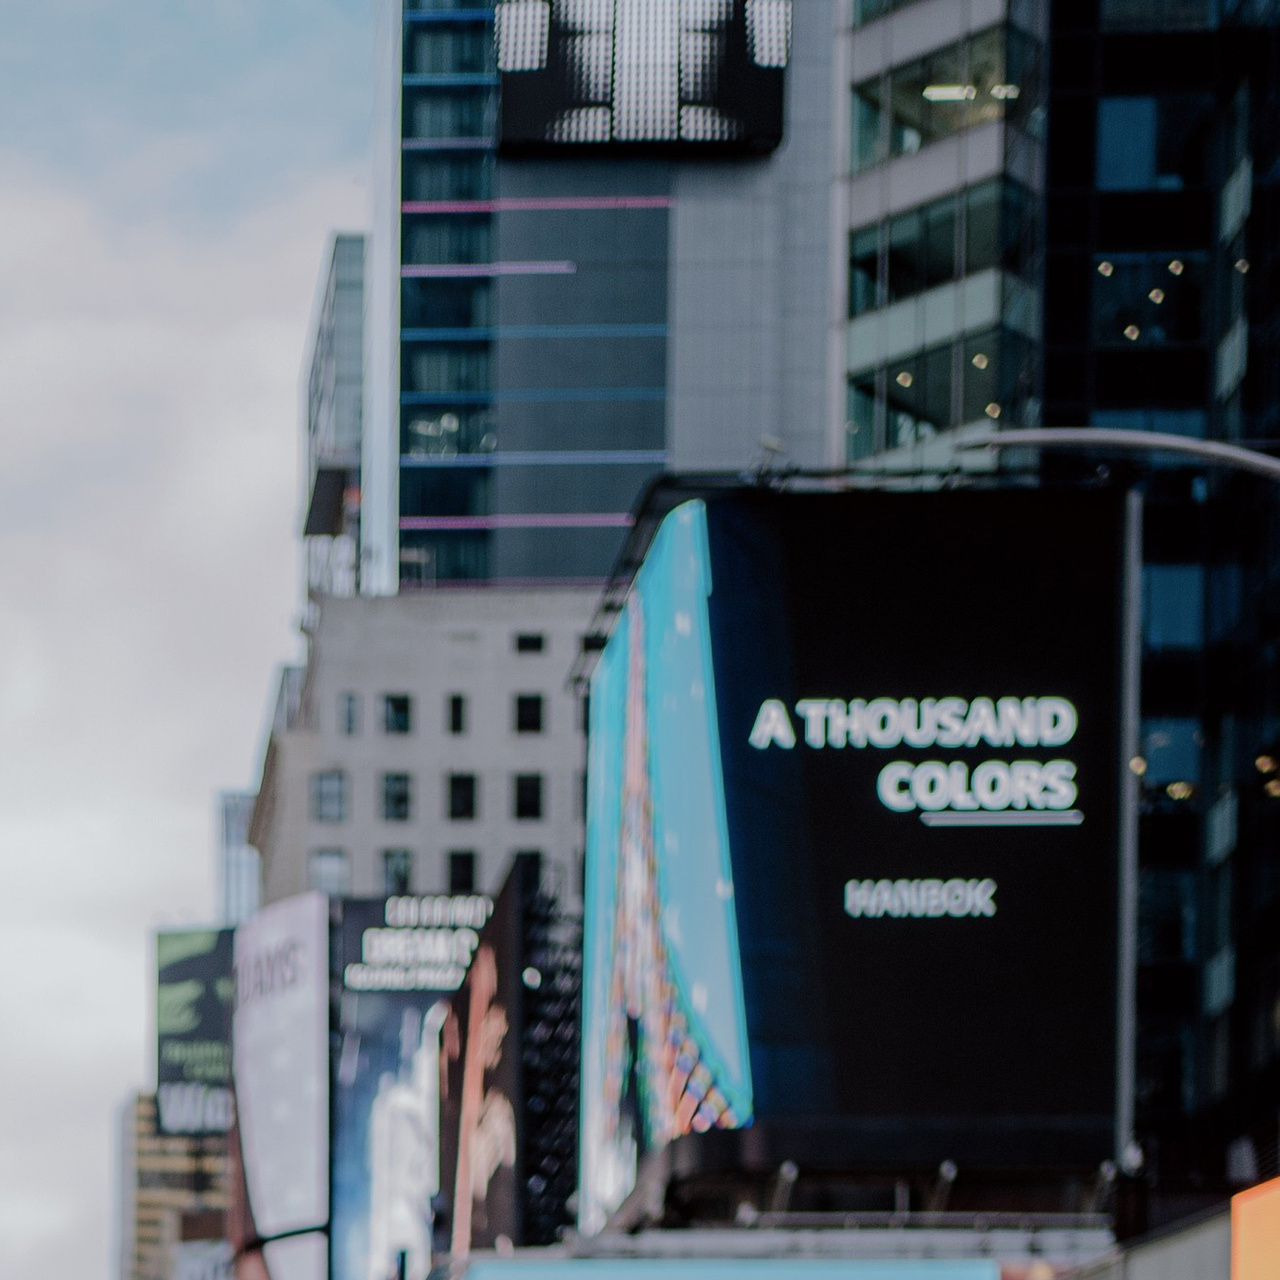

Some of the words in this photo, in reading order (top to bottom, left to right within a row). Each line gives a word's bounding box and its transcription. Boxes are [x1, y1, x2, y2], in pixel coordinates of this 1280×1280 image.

[749, 699, 795, 749] A
[795, 697, 1078, 748] THOUSAND
[877, 760, 1078, 812] COLORS
[844, 879, 998, 917] HANBOK
